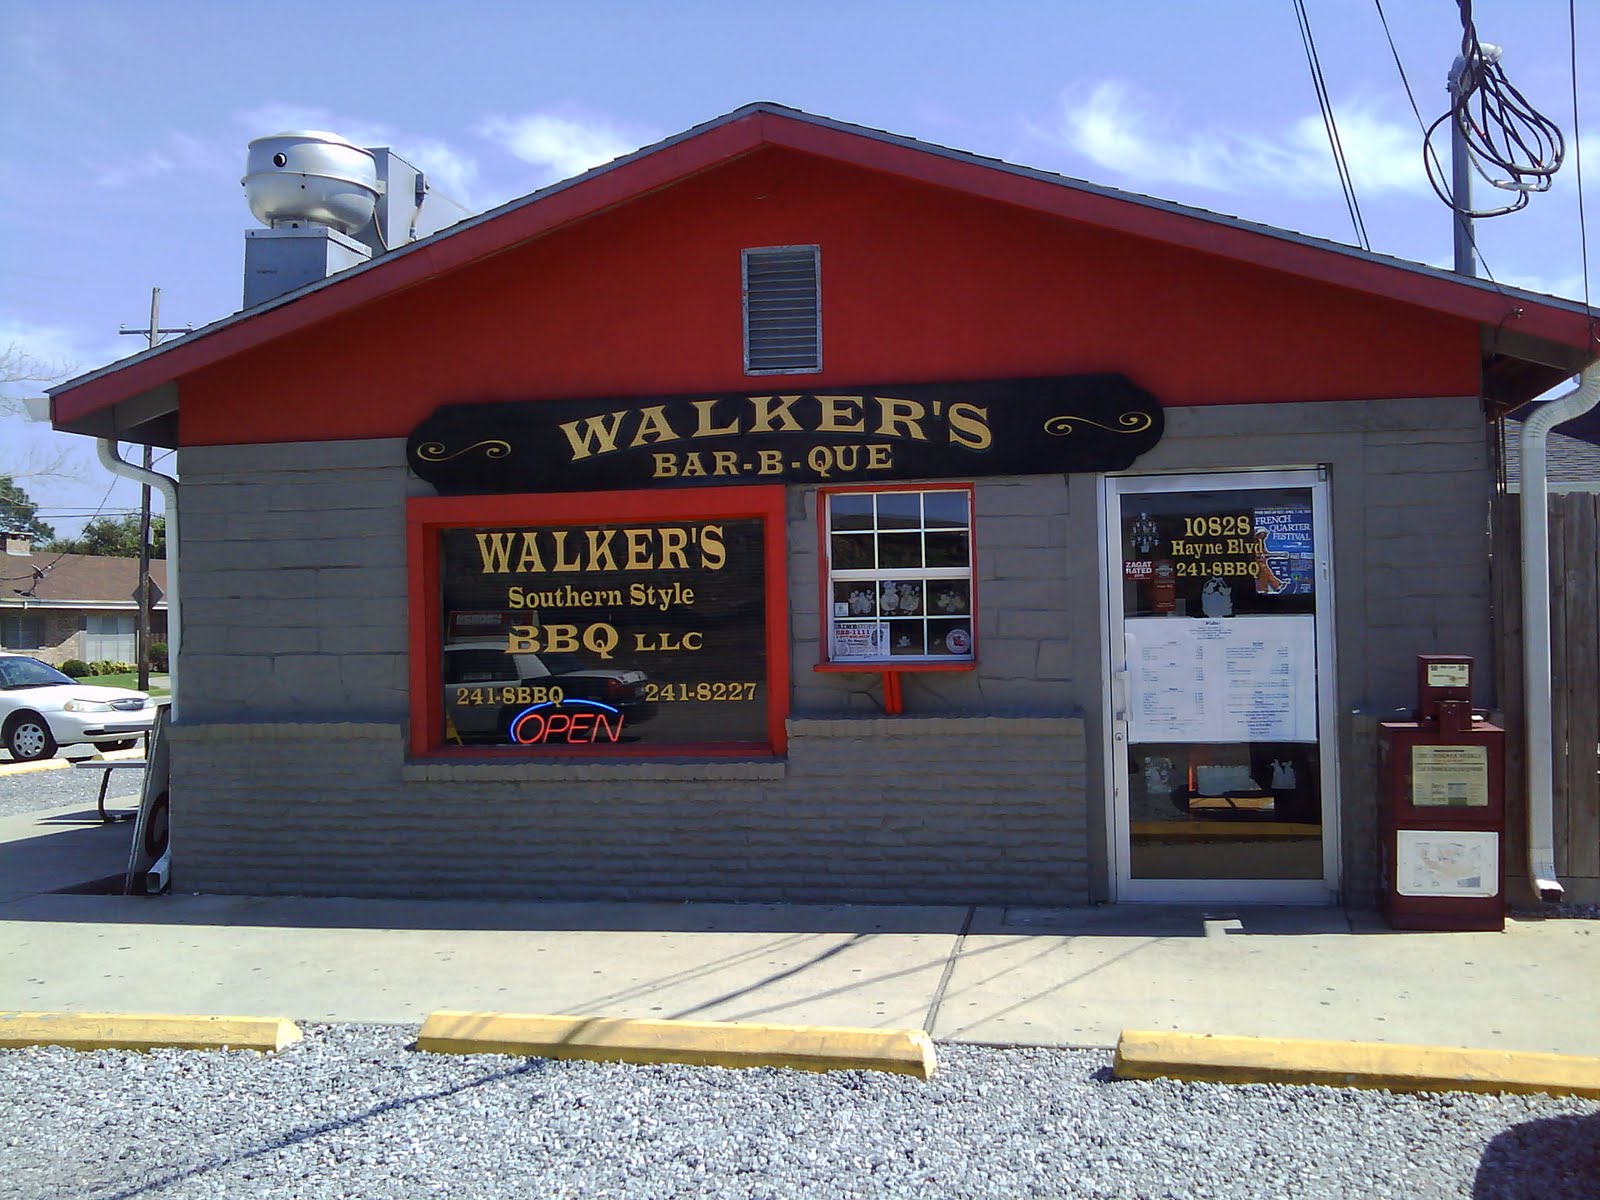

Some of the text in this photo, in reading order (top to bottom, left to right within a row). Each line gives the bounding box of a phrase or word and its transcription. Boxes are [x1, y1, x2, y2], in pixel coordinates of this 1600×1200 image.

[558, 395, 992, 461] WALKER'S
[1184, 516, 1251, 537] 10828
[1255, 515, 1291, 525] FRENCH
[1269, 523, 1311, 532] QUARTER
[1272, 532, 1311, 541] FESTIVAL
[475, 525, 727, 574] WALKER'S
[1171, 539, 1264, 559] Hayne Blvd
[1176, 561, 1260, 579] 241-8BBQ
[508, 582, 695, 611] Southern Style
[504, 622, 703, 659] BBQ LLC
[456, 686, 564, 708] 241-8BBQ
[645, 683, 757, 702] 241-8227
[516, 714, 624, 744] OPEN
